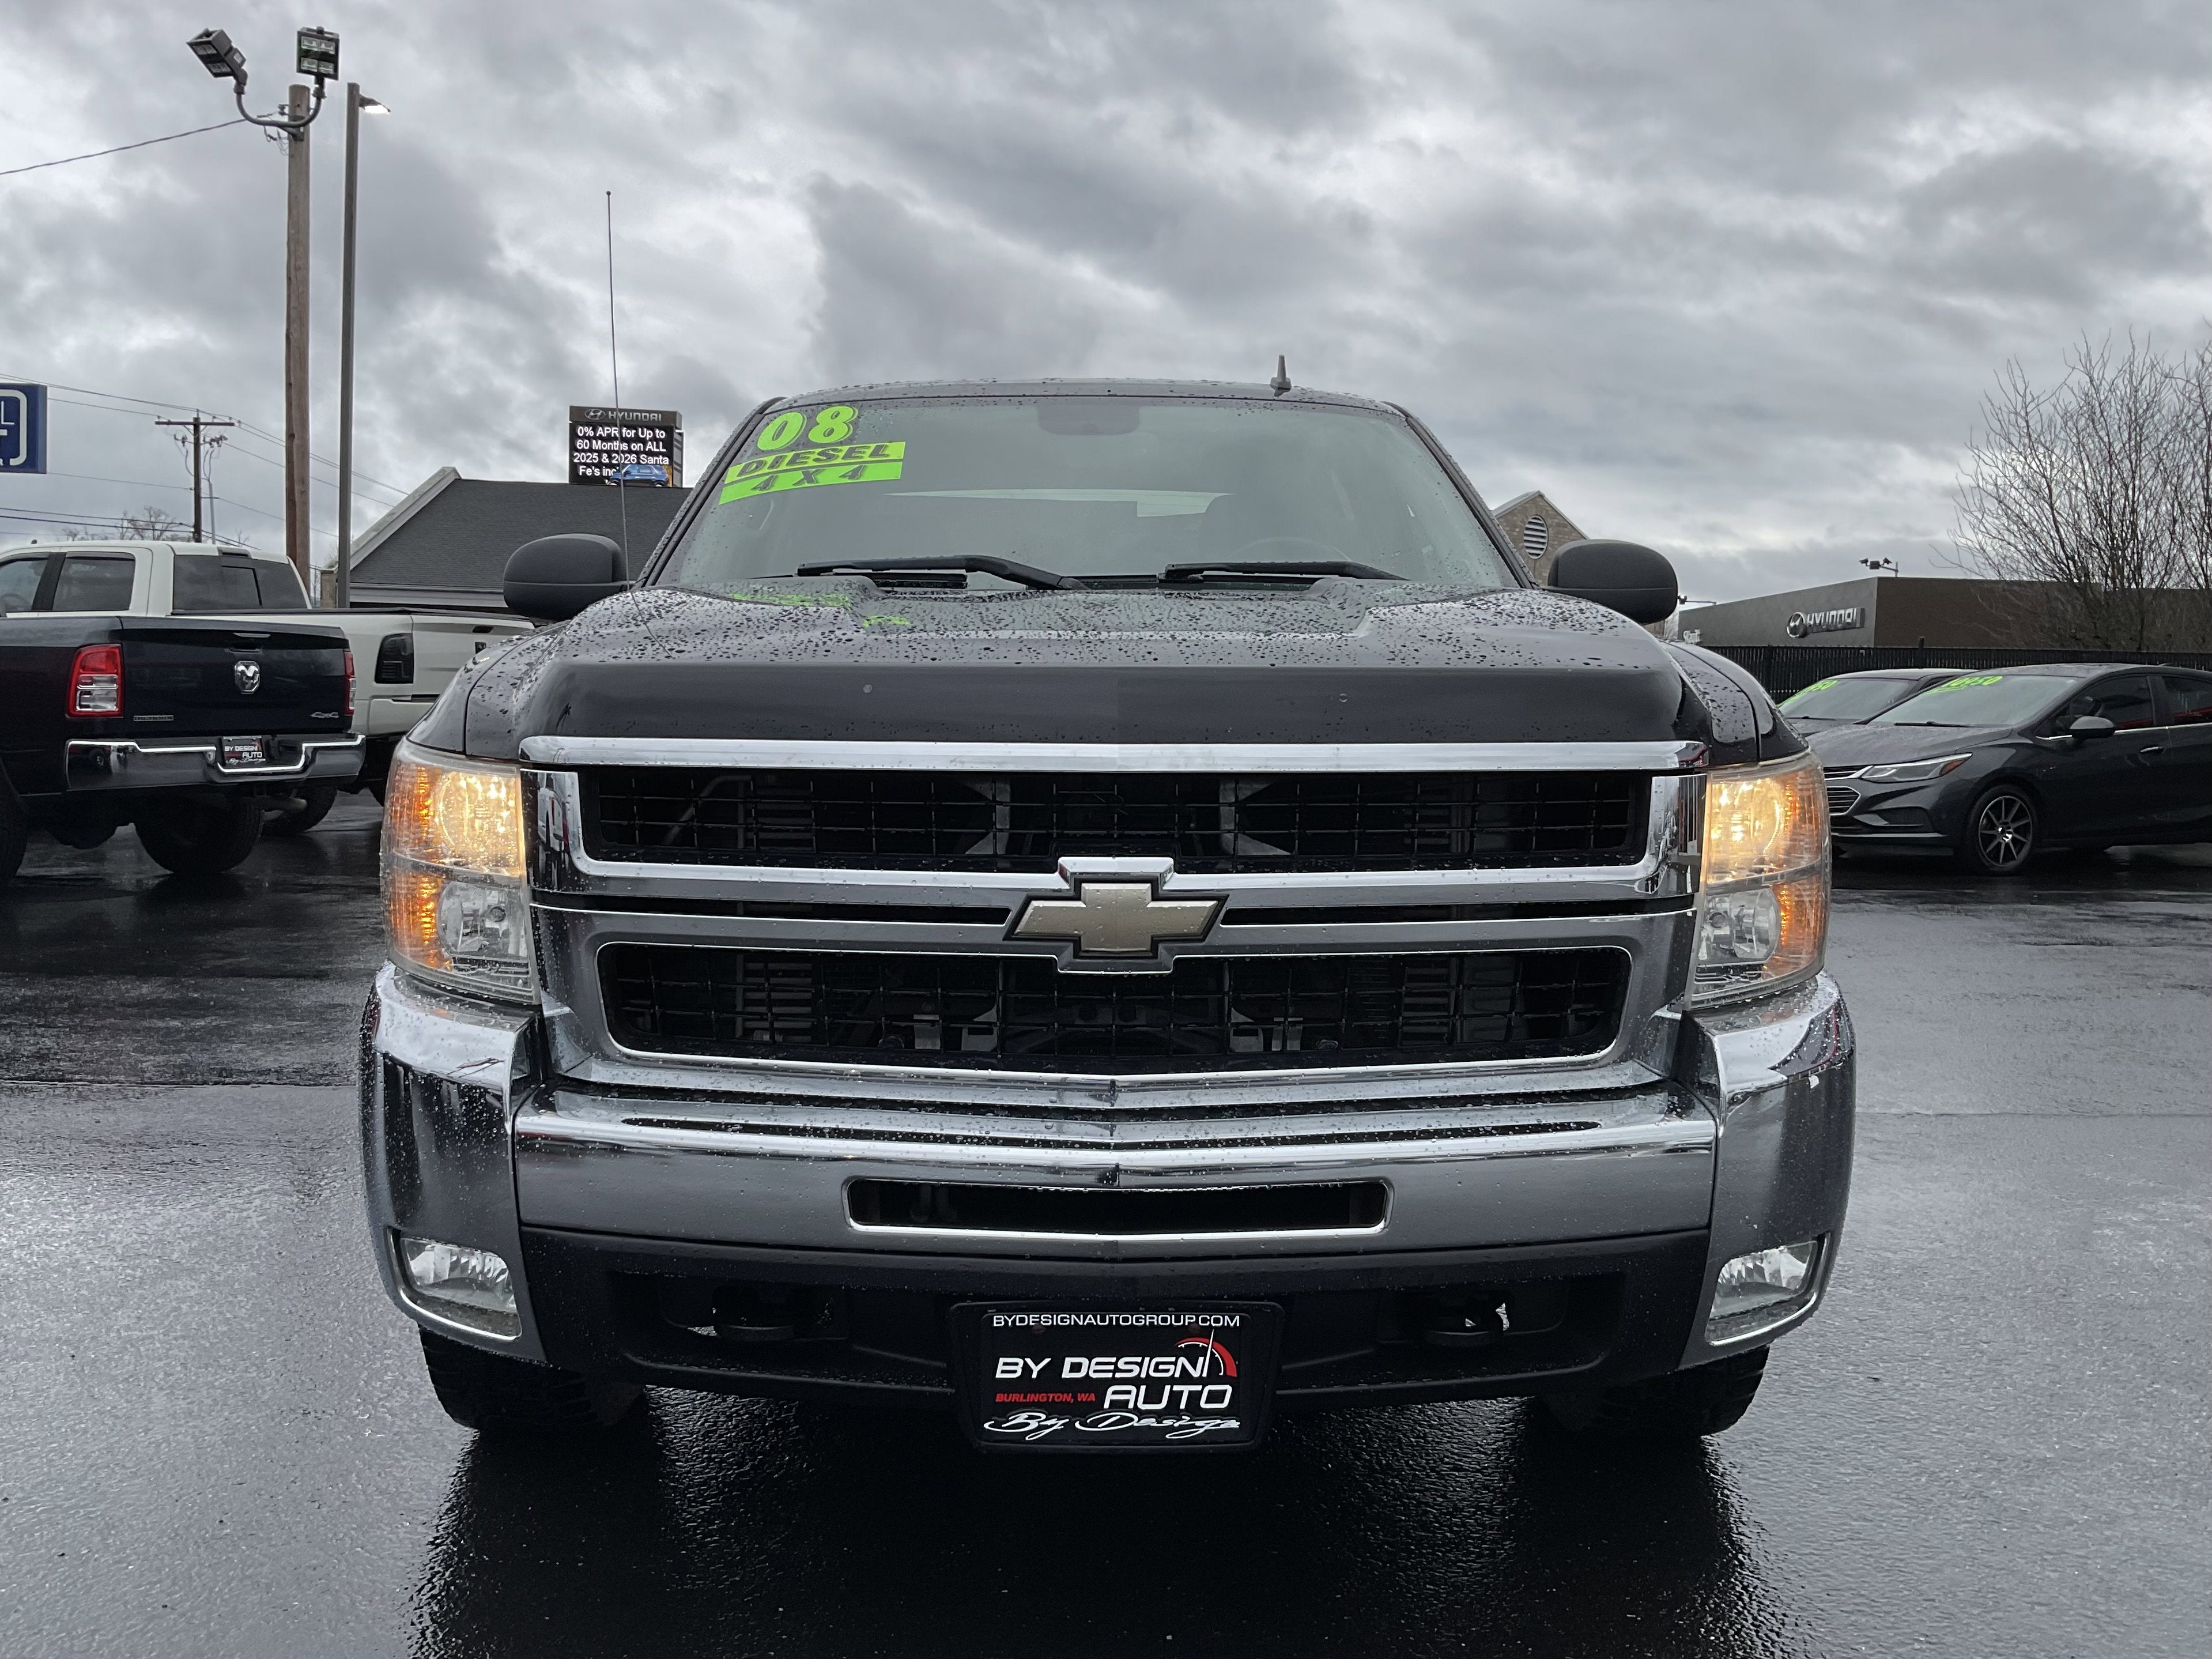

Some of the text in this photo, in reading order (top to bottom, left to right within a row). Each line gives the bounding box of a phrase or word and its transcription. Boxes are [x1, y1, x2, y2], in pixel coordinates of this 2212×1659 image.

[608, 411, 662, 422] HYUNDAI
[577, 426, 666, 440] 0% APR for Up to
[757, 405, 858, 451] 08
[576, 439, 666, 451] 60 Months on ALL
[573, 453, 669, 465] 2025 & 2026 Santa
[737, 444, 890, 477] DIESEL
[579, 465, 601, 476] Fe's
[992, 1314, 1240, 1327] BYDESIGNAUTOGROUPCOM
[995, 1356, 1207, 1378] BY DESIGN
[995, 1393, 1096, 1403] BURLINGTON, WA
[1103, 1385, 1232, 1409] AUTO
